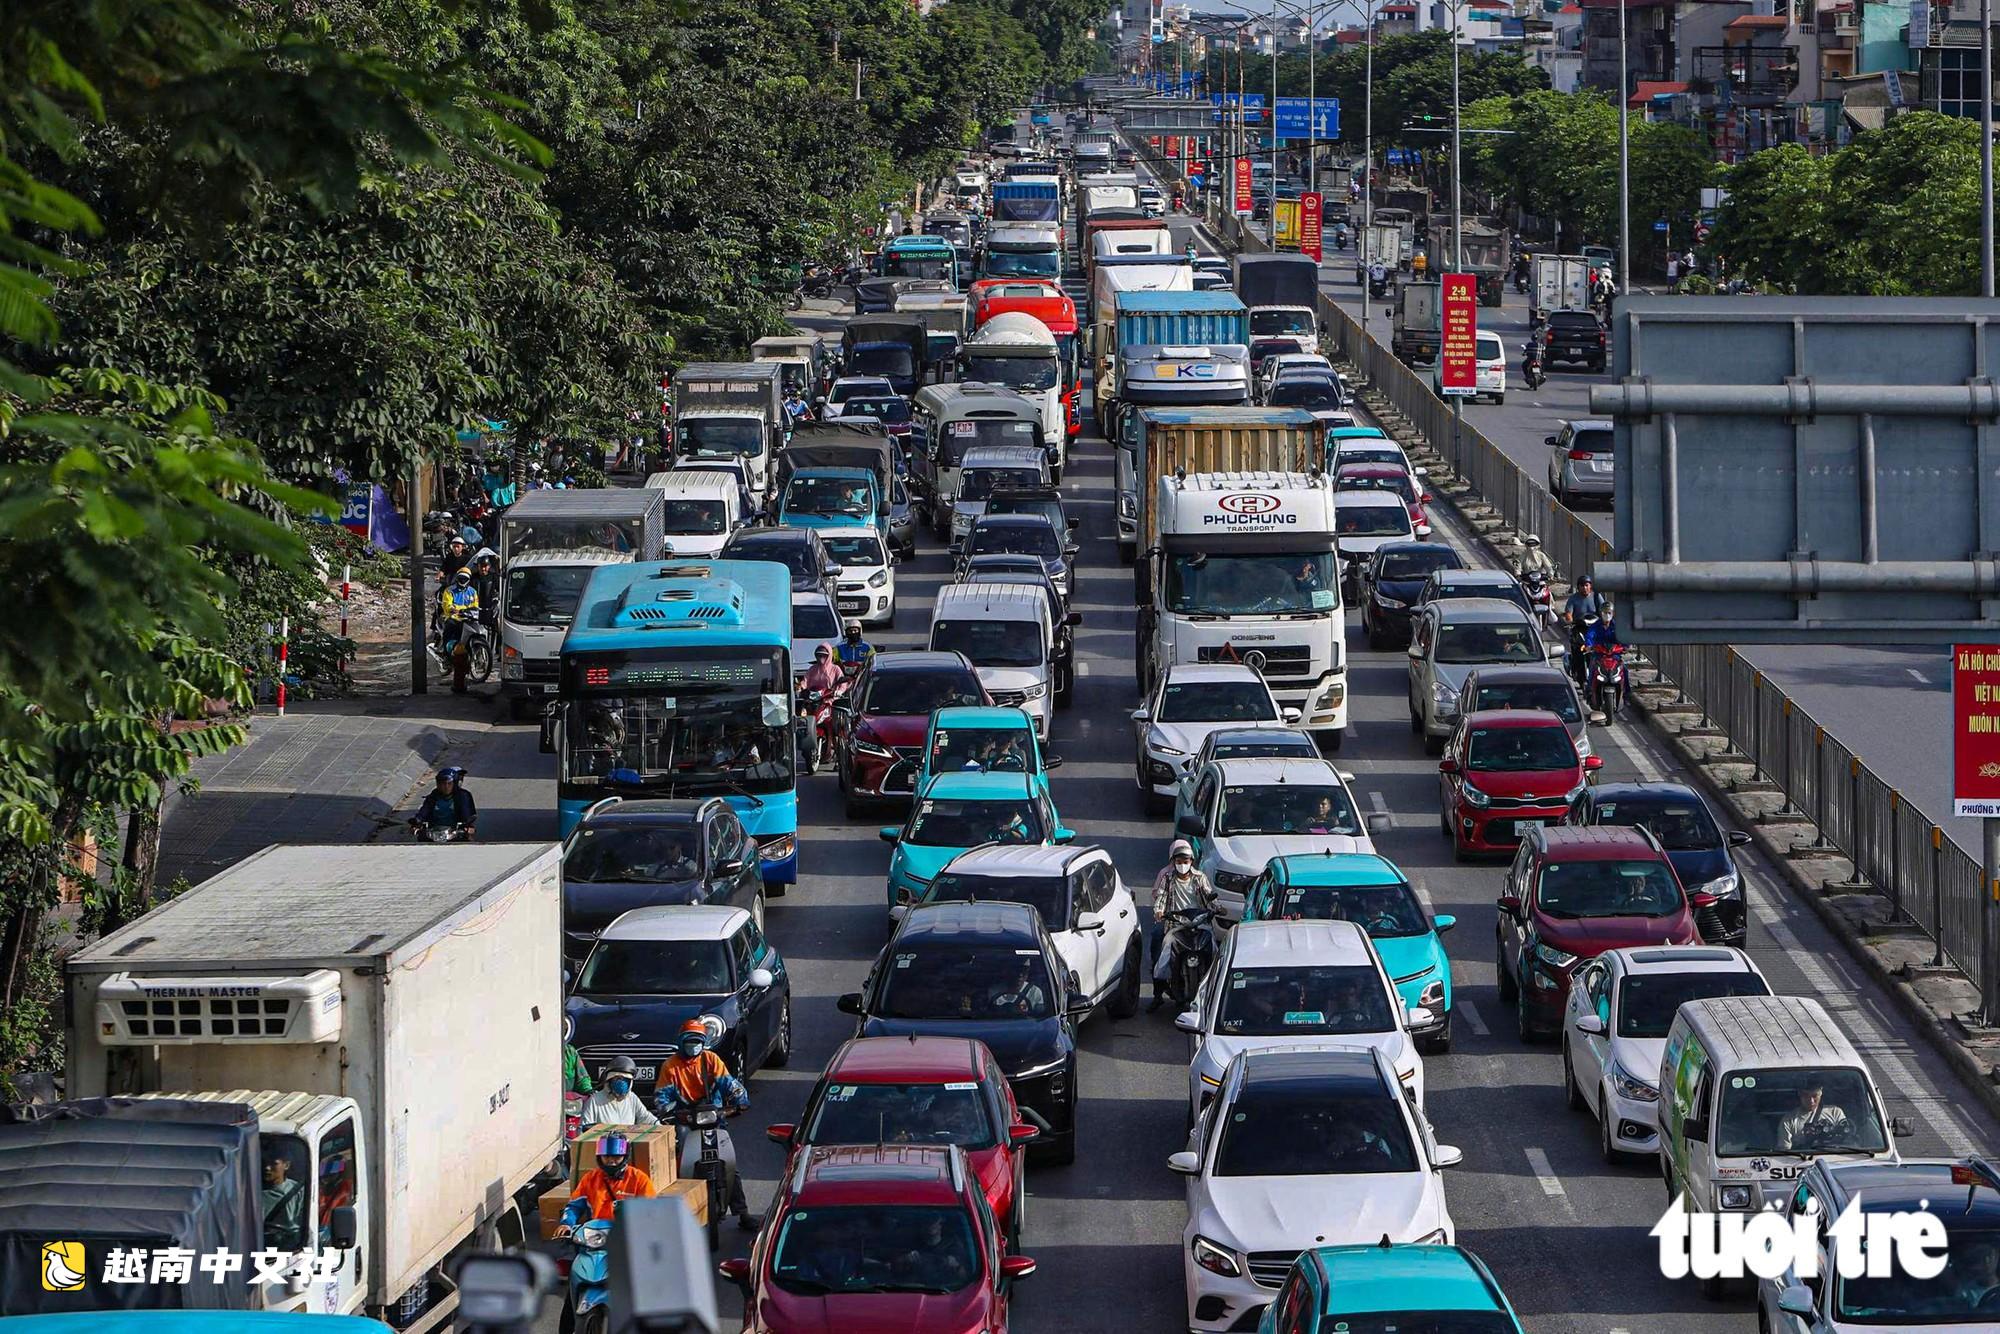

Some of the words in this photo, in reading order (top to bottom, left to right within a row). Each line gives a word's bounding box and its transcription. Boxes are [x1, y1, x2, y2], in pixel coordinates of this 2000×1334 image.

[1451, 285, 1467, 296] 2-9
[1203, 514, 1297, 525] PHUCHUNG
[1958, 650, 1970, 671] XÃ
[1970, 650, 1984, 675] HỘI
[1974, 681, 1991, 705] VIỆT
[1968, 711, 1992, 733] MUÔN
[1961, 802, 1994, 815] PHƯỜNG
[144, 987, 205, 998] THERMAL
[208, 986, 261, 997] MASTER
[1222, 1019, 1244, 1028] TAXI
